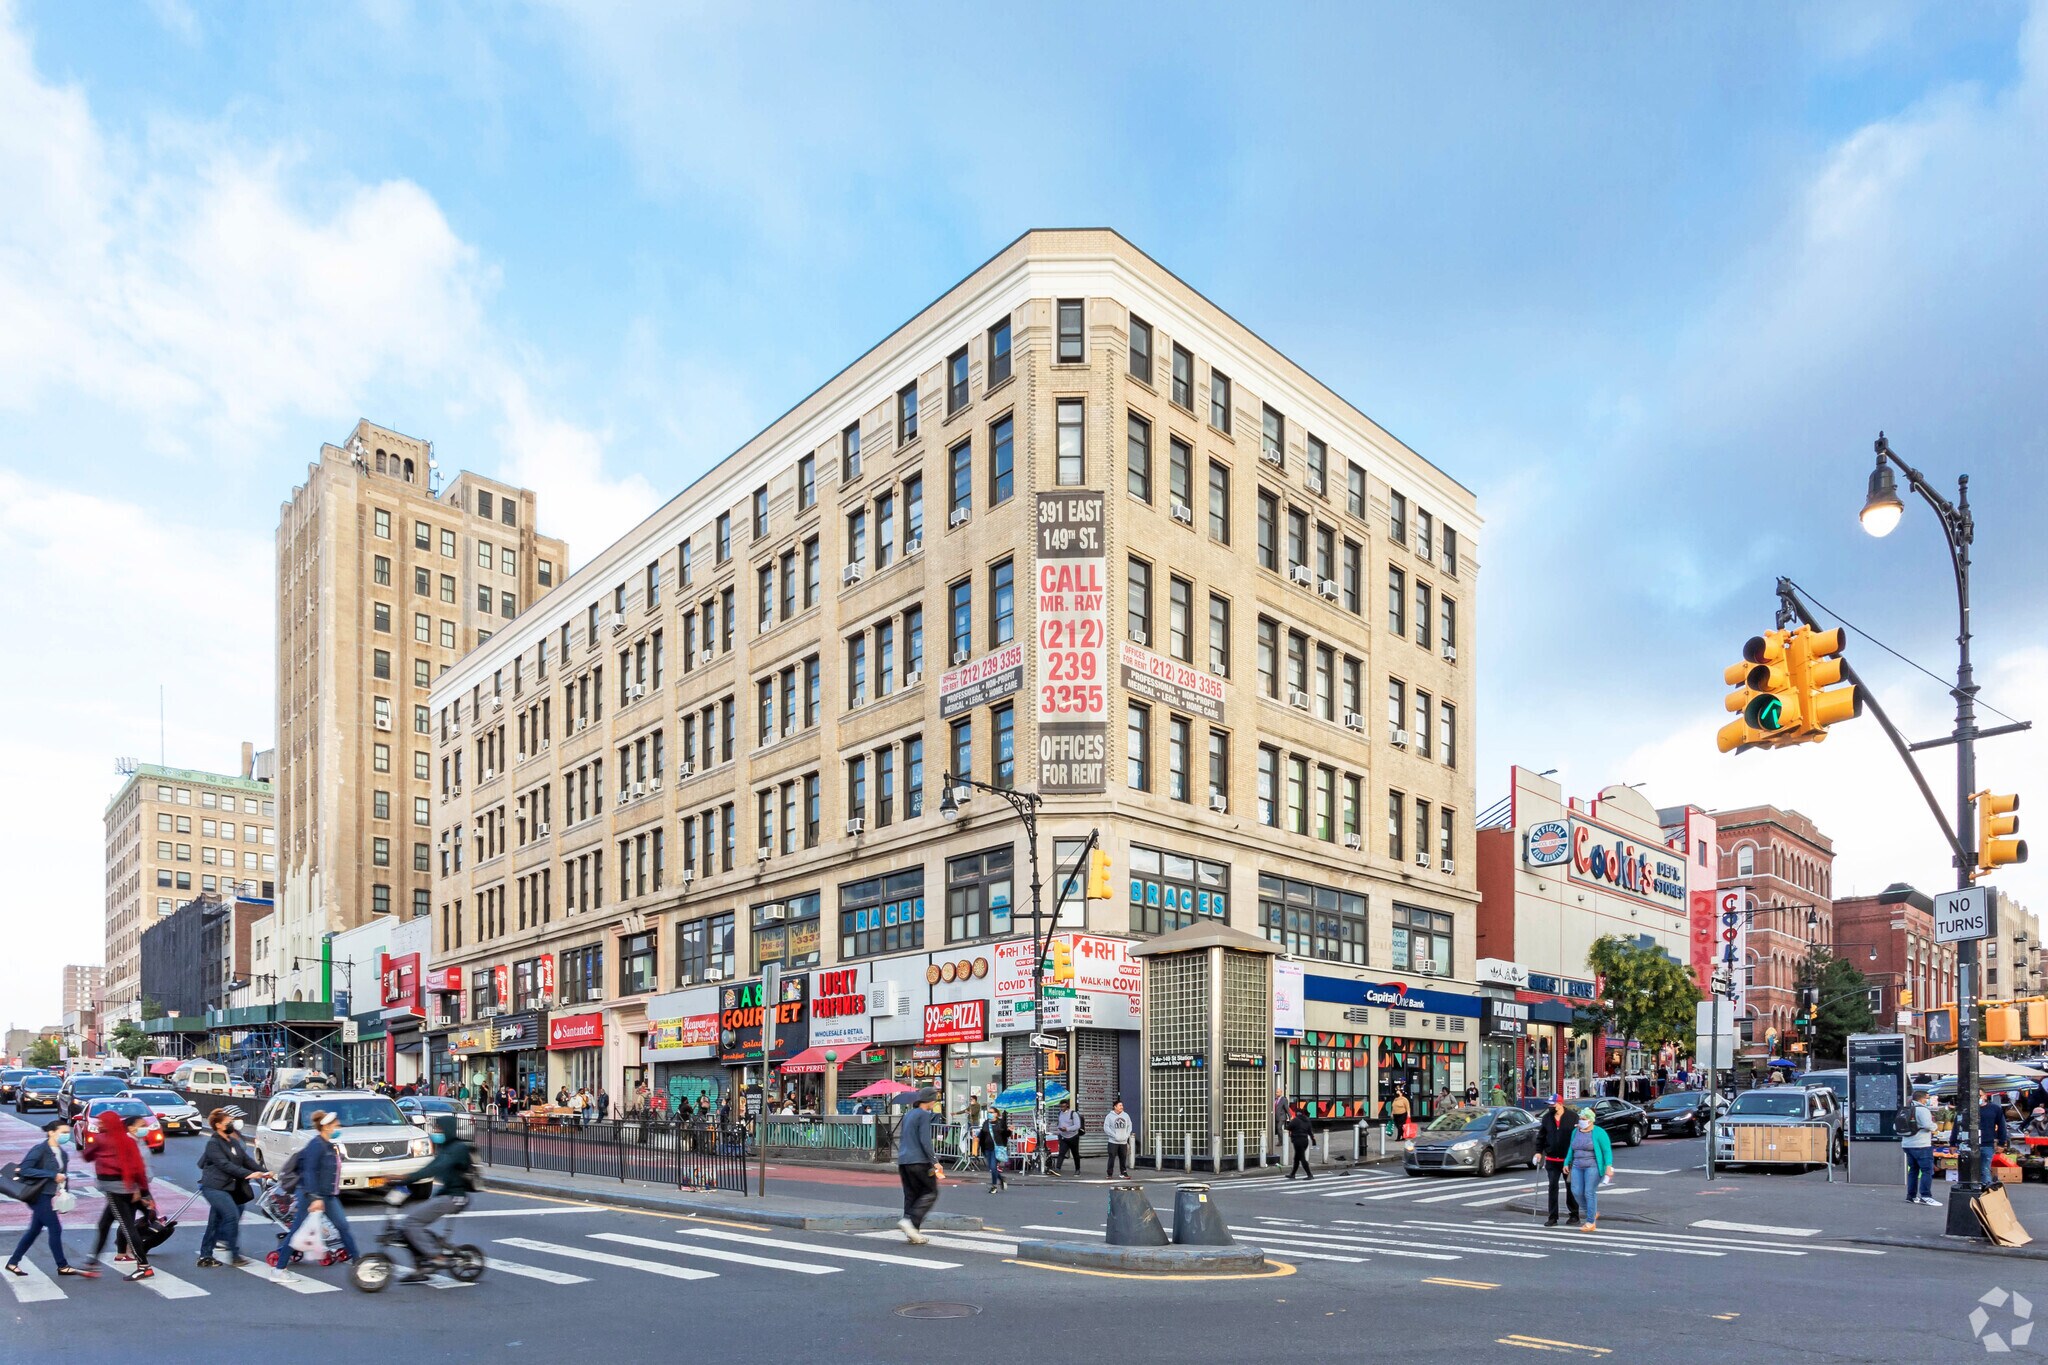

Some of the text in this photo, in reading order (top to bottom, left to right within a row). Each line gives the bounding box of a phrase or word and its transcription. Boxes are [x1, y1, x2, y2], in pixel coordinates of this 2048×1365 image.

[1039, 500, 1102, 523] 391 EAST
[1079, 527, 1099, 549] ST.
[1040, 565, 1103, 593] CALL
[1040, 595, 1103, 611] MR. RAY
[1040, 619, 1104, 649] (212)
[1123, 654, 1147, 670] FOR RENT
[1124, 645, 1146, 661] OFFICES
[960, 646, 1022, 686] (212) 239 3355
[1048, 651, 1096, 680] 239
[946, 670, 1016, 704] PROFESSIONAL NON-PROFIT
[1149, 657, 1222, 698] (212) 239 3355
[944, 680, 1018, 714] MEDICAL LEGAL HOME CARE
[1041, 685, 1103, 713] 3355
[1127, 678, 1219, 719] MEDICAL LEGAL HOME CARE
[1130, 670, 1216, 708] PROFESSIONAL NON-PROFIT
[1040, 735, 1104, 761] OFFICES
[1042, 763, 1102, 785] FOR RENT
[1534, 824, 1566, 840] OFFICIAL
[1573, 826, 1654, 896] Cookie's
[1131, 881, 1224, 914] BRACES
[1654, 878, 1686, 900] STORES
[845, 898, 924, 934] BRACES
[1949, 897, 1970, 914] NO
[1937, 915, 1984, 934] TURNS
[1005, 946, 1019, 957] RH
[1094, 941, 1116, 960] RH
[1120, 966, 1132, 974] NOW
[819, 969, 858, 997] LUCKY
[998, 979, 1026, 991] COVID
[1047, 987, 1066, 997] Melrose
[1080, 975, 1141, 991] WALK-IN COVI
[1528, 975, 1556, 992] GIRLS
[741, 985, 752, 1008] A
[812, 994, 866, 1018] PERFUMES
[1016, 1003, 1020, 1011] E
[1020, 1001, 1029, 1010] 149
[1366, 990, 1397, 1004] Capital
[1408, 998, 1425, 1009] Bank
[722, 1001, 802, 1031] GOURET
[953, 1002, 982, 1029] PIZZA
[997, 1009, 1013, 1017] RENT
[1043, 1005, 1060, 1013] RENT
[1074, 1005, 1091, 1013] RENT
[562, 1020, 595, 1038] Santander
[814, 1029, 843, 1038] WHOLESALE
[806, 1064, 826, 1072] PERFU
[1300, 1056, 1351, 1070] MOSAICO
